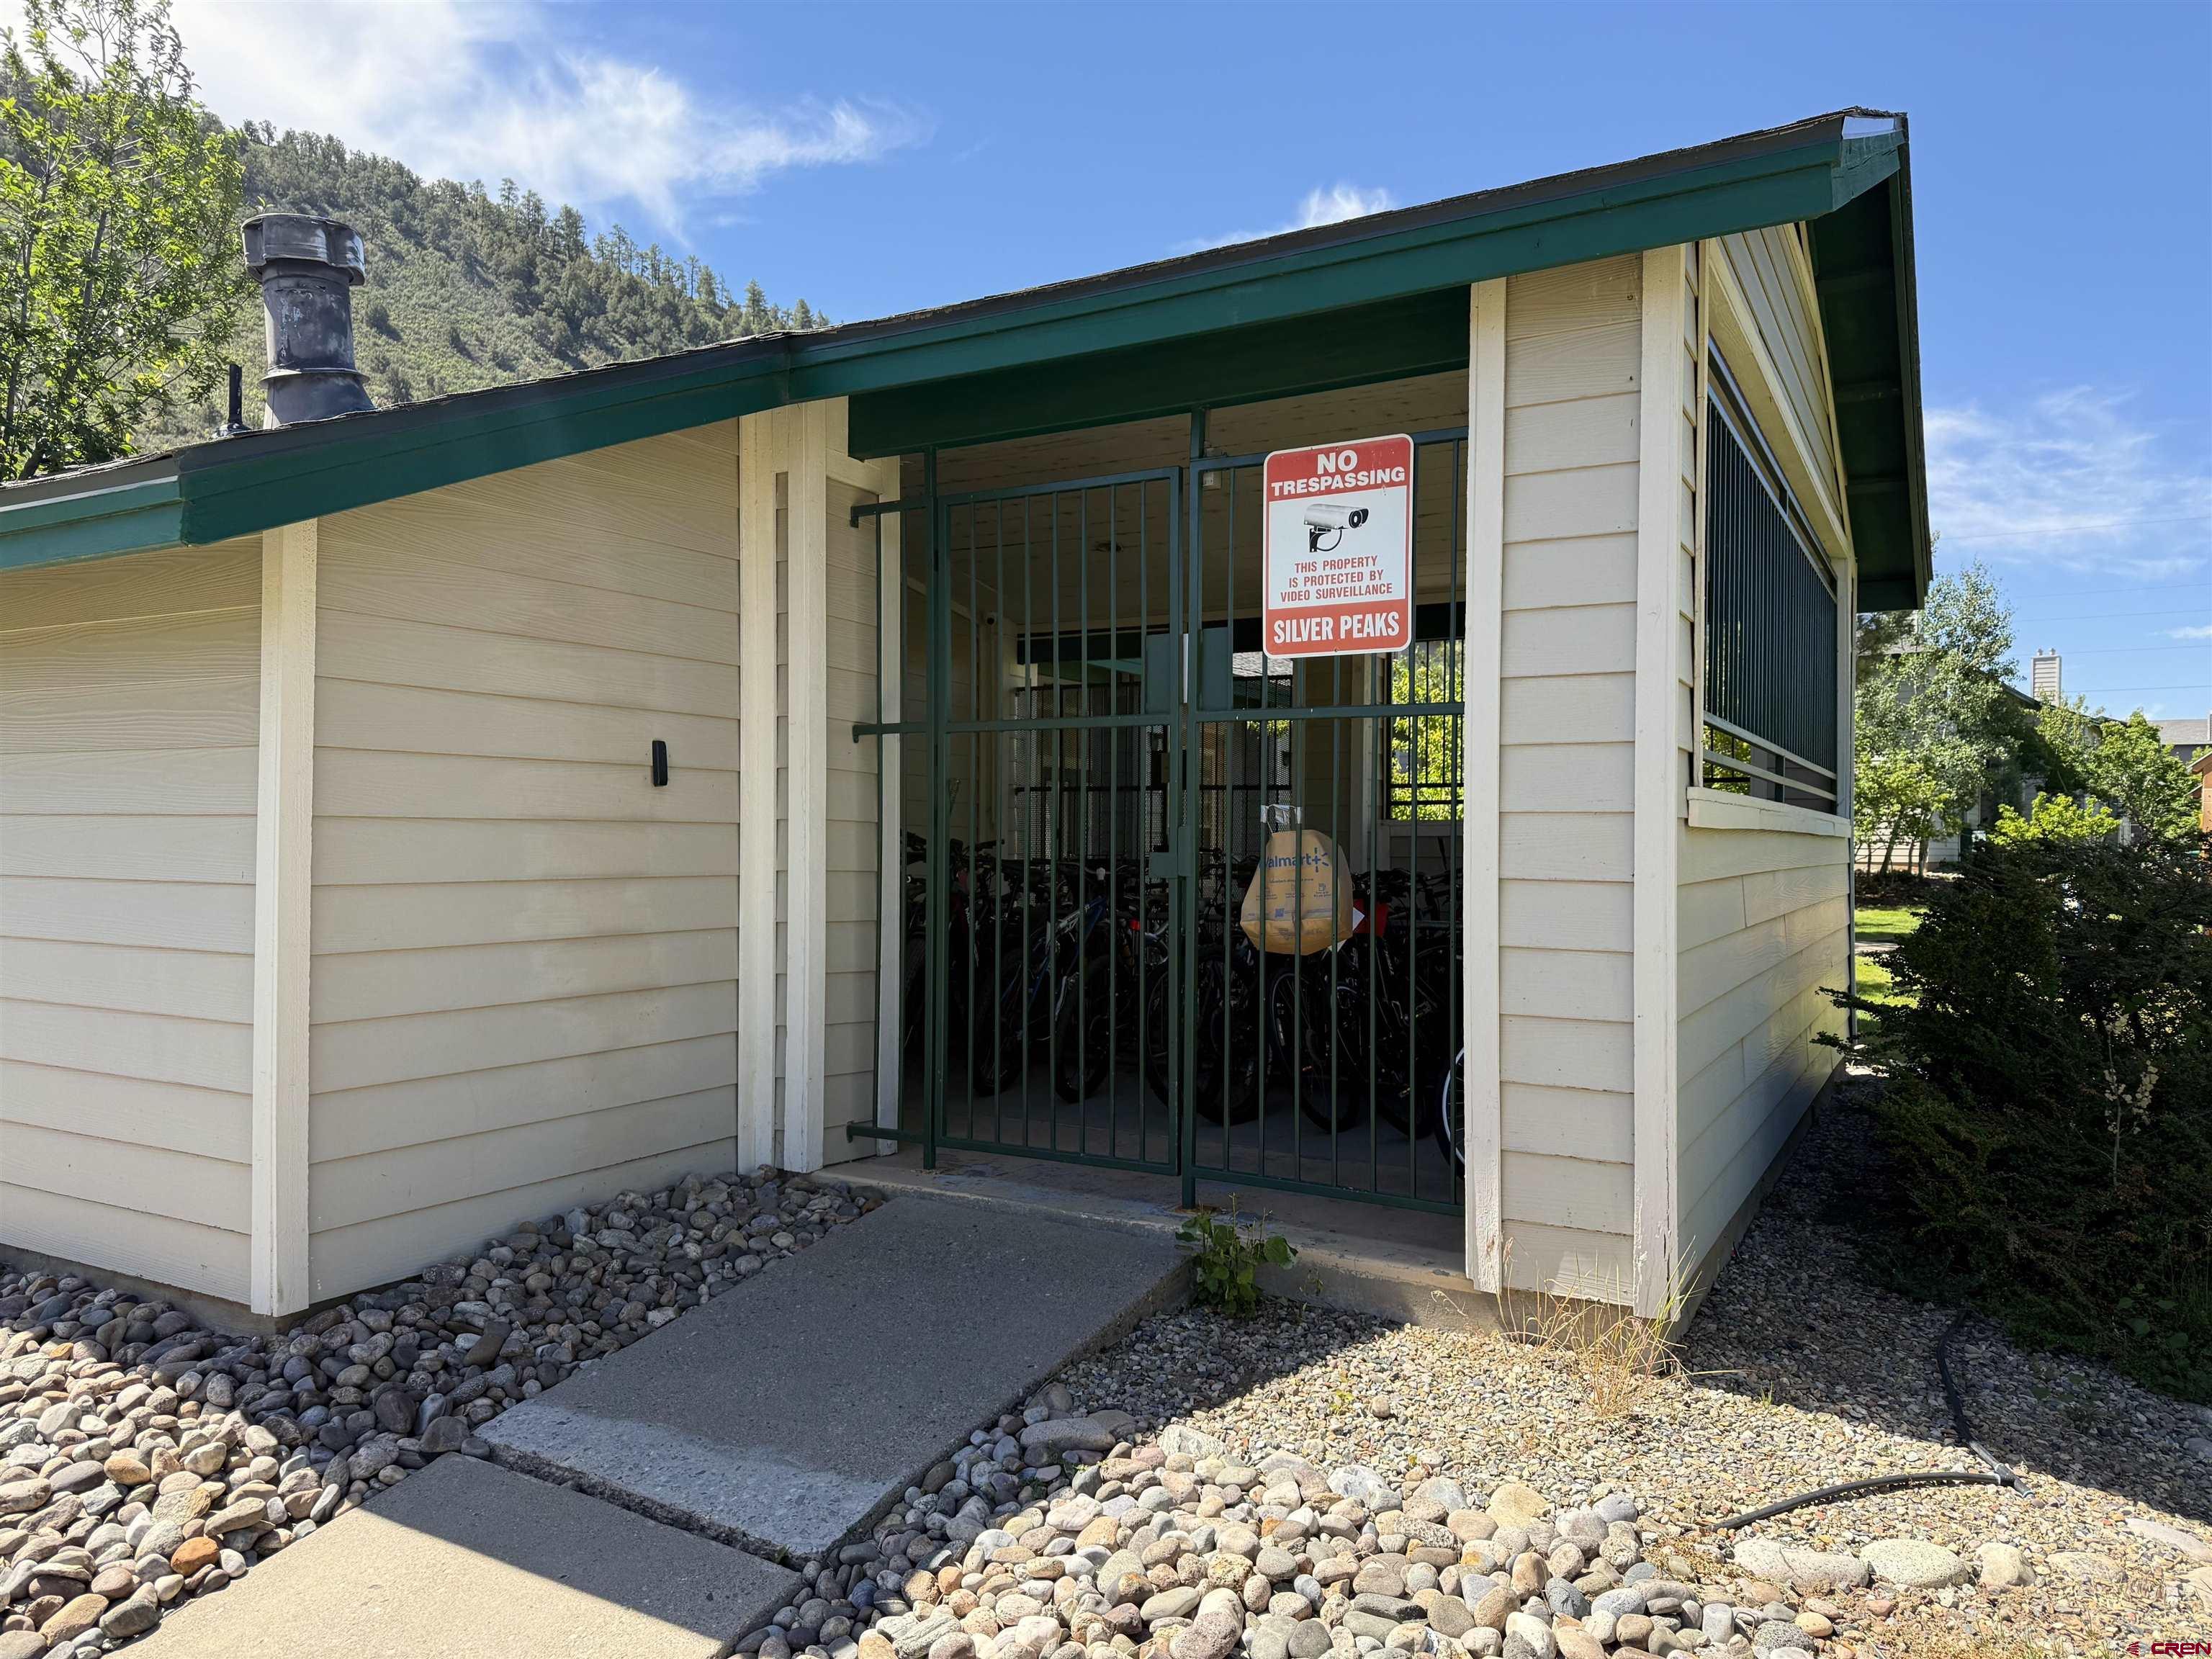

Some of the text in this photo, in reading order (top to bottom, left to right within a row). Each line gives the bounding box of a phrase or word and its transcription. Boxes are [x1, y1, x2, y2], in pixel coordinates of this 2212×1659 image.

[1317, 449, 1357, 475] NO
[1272, 467, 1405, 495] TRESPASSING
[1295, 556, 1377, 573] THIS PROPERTY
[1289, 570, 1383, 588] IS PROTECTED BY
[1281, 583, 1393, 602] VIDEO SURVEILLANCE
[1274, 612, 1400, 644] SILVER PEAKS
